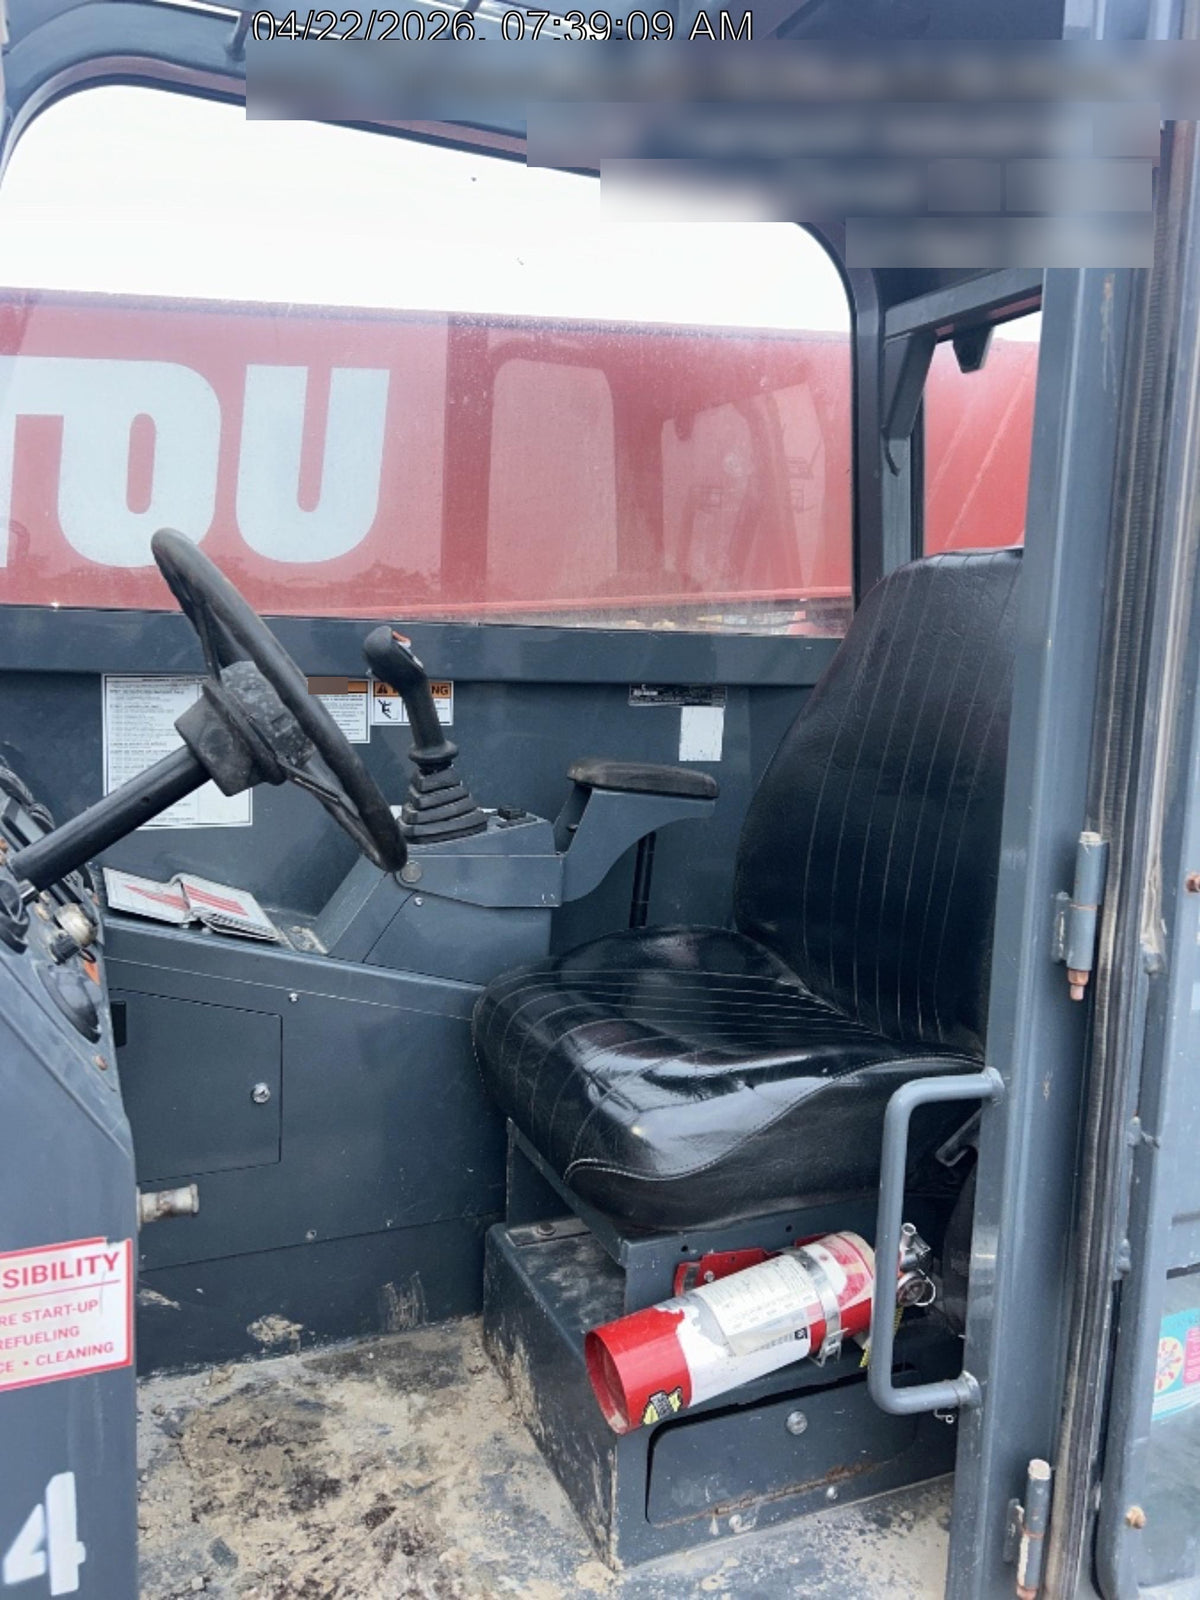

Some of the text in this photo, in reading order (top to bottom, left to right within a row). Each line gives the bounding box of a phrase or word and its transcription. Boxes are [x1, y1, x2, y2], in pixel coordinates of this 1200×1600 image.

[2, 1251, 120, 1290] SIBILITY
[22, 1299, 98, 1323] START-UP
[36, 1341, 114, 1367] CLEANING
[3, 1471, 86, 1596] 4
